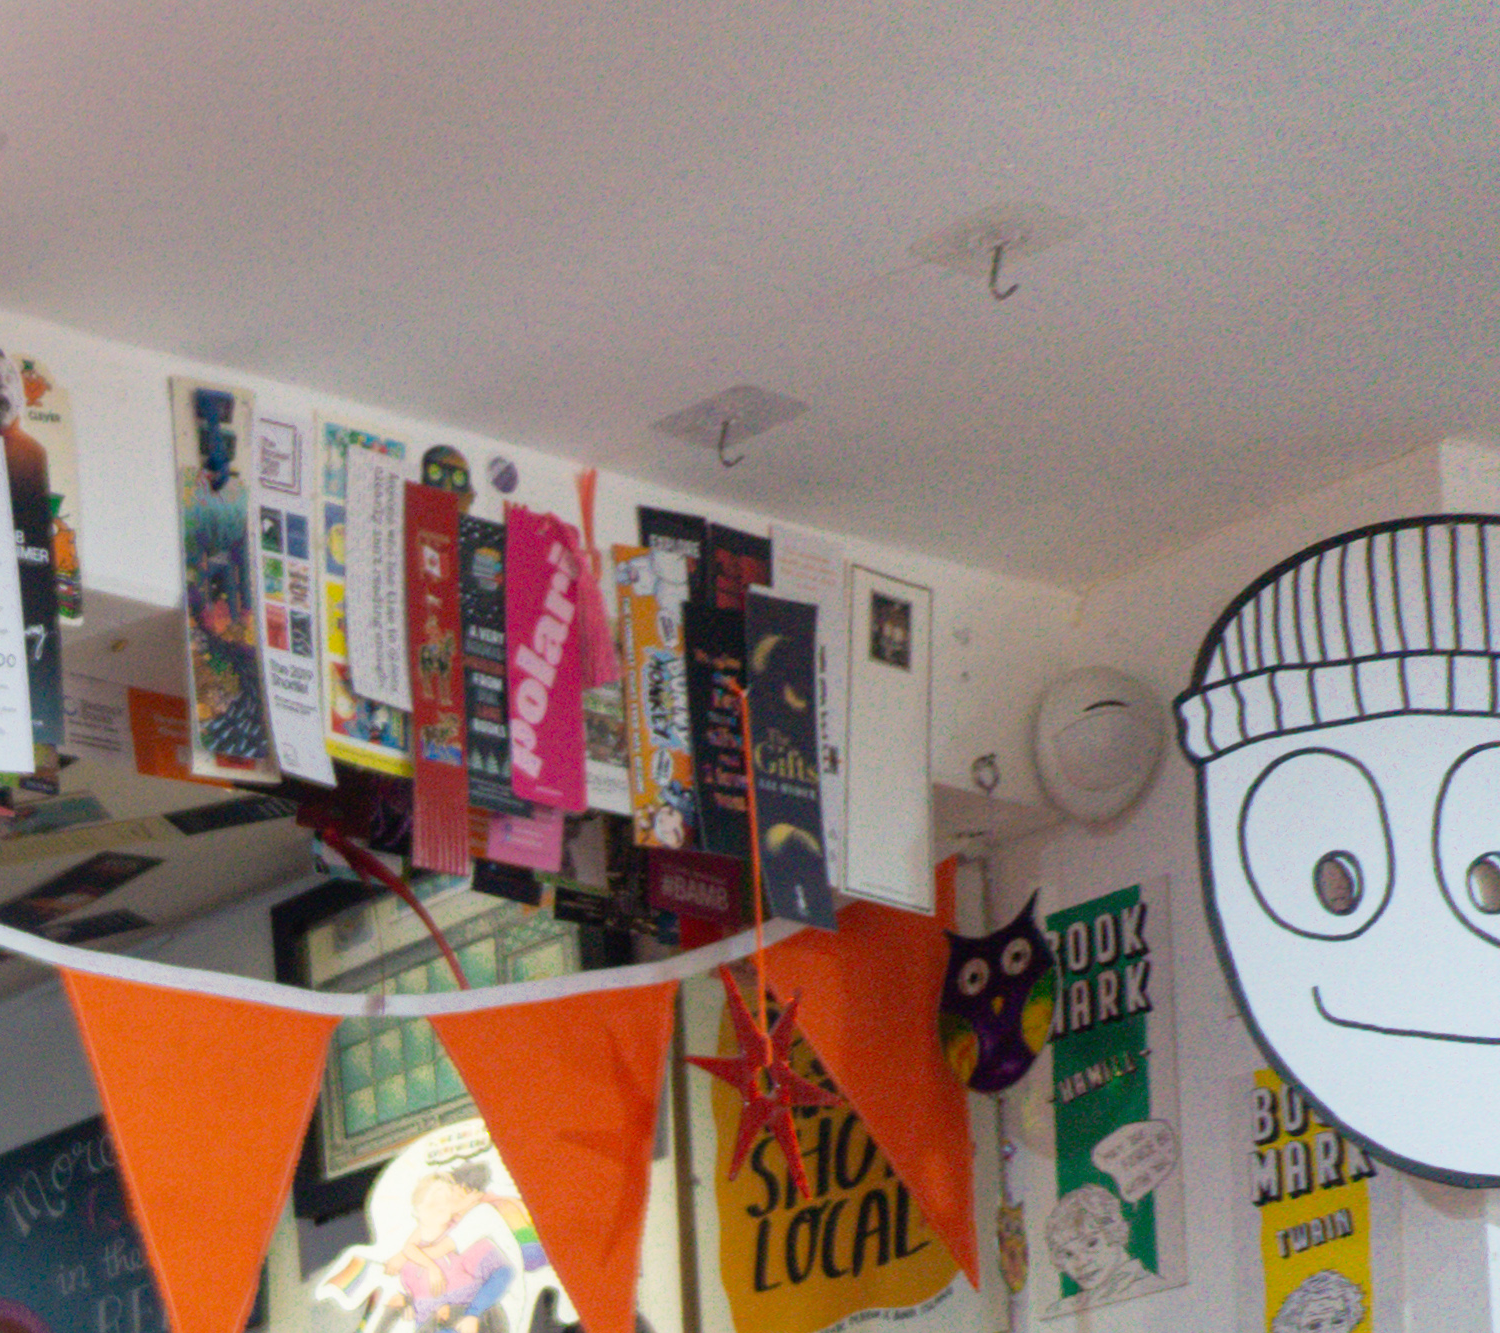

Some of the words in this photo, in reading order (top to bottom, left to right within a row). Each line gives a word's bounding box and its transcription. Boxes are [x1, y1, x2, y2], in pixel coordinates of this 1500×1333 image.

[510, 541, 579, 779] polari
[755, 741, 818, 779] Gifts
[753, 1180, 931, 1294] LOCAL
[1276, 1208, 1354, 1258] TWAIN
